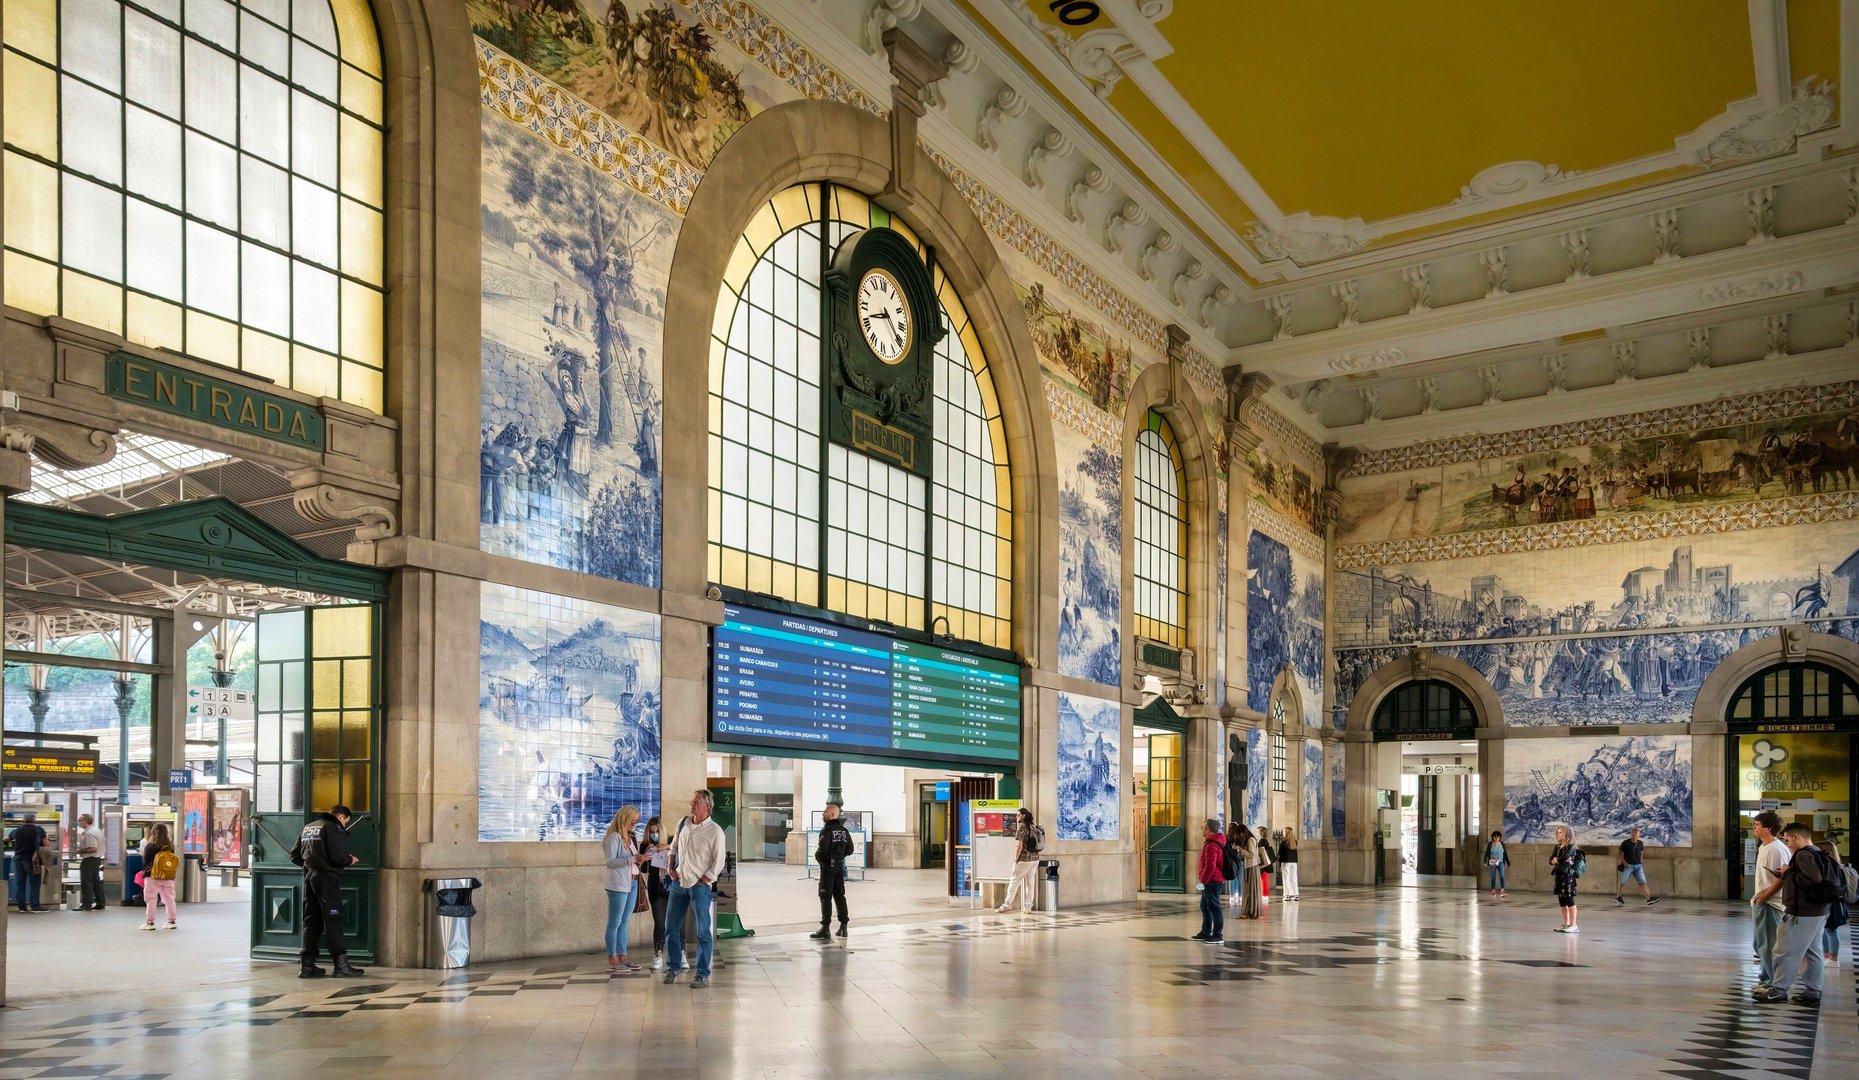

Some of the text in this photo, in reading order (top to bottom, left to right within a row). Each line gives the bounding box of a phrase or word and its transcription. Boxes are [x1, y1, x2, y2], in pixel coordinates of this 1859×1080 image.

[125, 362, 308, 441] ENTRADA
[864, 420, 905, 455] PORTO
[783, 620, 806, 630] PARTIDAS
[808, 626, 838, 637] DEPARTURES
[740, 646, 763, 654] GUIMARÃES
[755, 660, 778, 668] CANAVESES
[942, 653, 960, 661] CHEGADAS
[962, 657, 978, 665] ARRIVALS
[1746, 771, 1807, 781] CENTRO DA
[1754, 781, 1827, 791] MOBILIDADE
[302, 826, 323, 836] PSG
